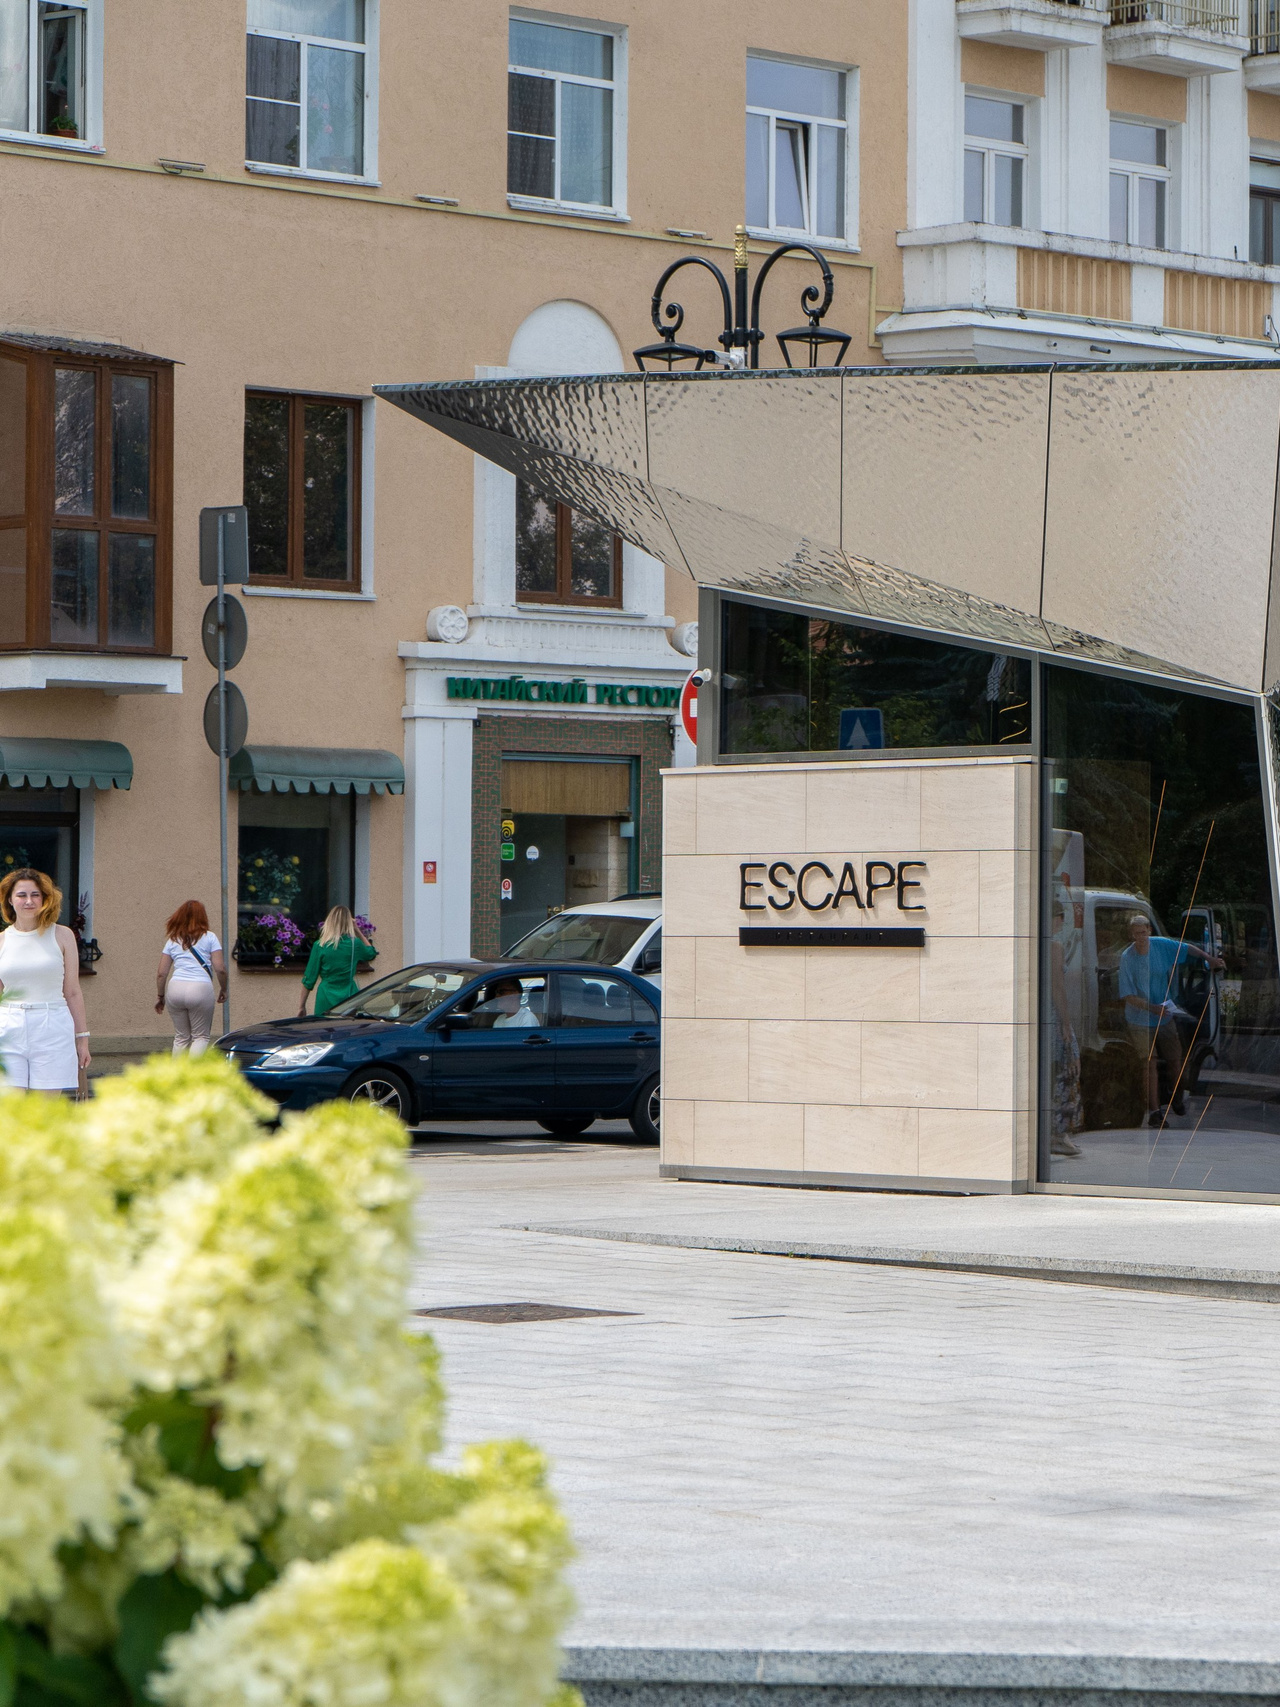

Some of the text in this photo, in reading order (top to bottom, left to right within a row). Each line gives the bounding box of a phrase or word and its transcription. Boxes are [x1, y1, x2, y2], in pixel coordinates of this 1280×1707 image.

[447, 675, 682, 708] КИТАЙСКИЙ РЕСТОР
[739, 861, 926, 911] ESCAPE
